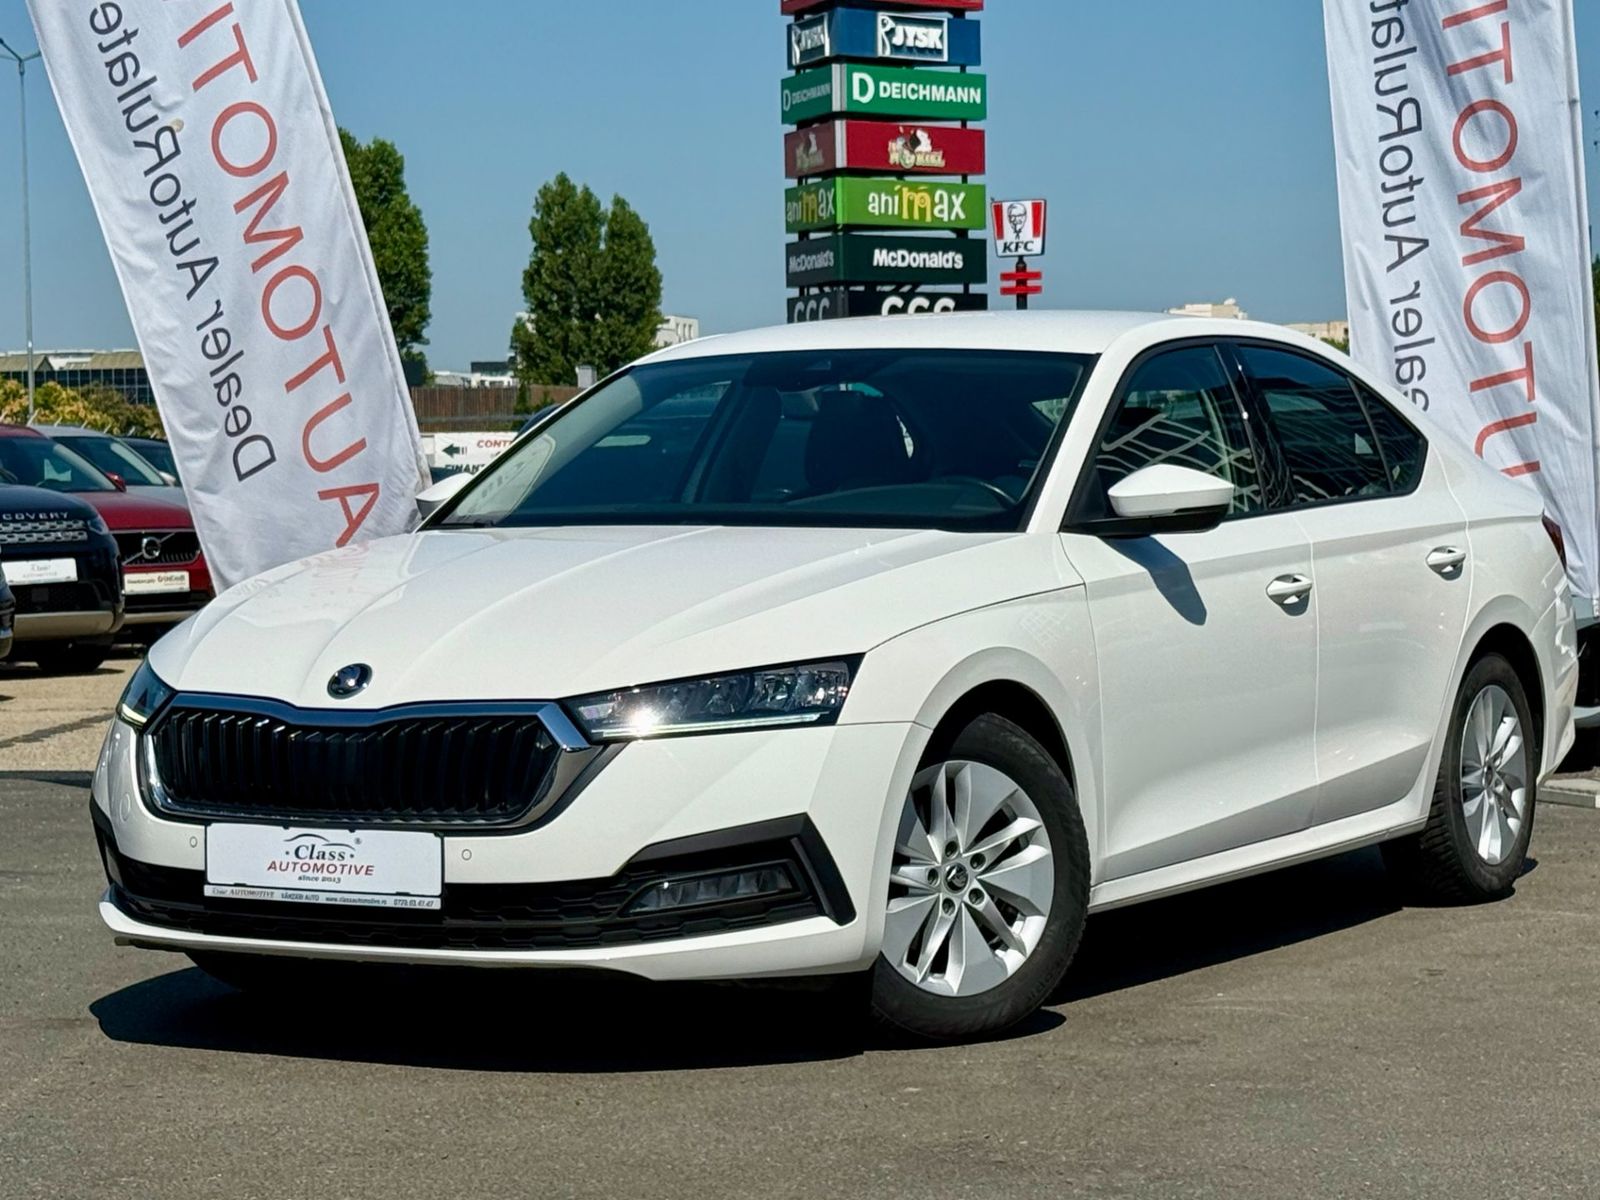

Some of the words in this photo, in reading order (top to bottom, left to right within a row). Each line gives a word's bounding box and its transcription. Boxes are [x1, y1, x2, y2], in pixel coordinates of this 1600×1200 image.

[801, 25, 826, 51] JYSK
[892, 25, 943, 50] JYSK
[792, 83, 832, 105] DEICHMANN
[879, 81, 982, 104] DEICHMANN
[786, 186, 836, 224] animax
[867, 185, 967, 223] animax
[1002, 240, 1035, 254] KFC
[788, 249, 835, 274] McDonald's
[873, 248, 964, 269] McDonald's
[476, 439, 513, 449] CONT
[294, 844, 346, 861] Class
[267, 860, 375, 876] AUTOMOTIVE
[321, 876, 342, 884] 2013
